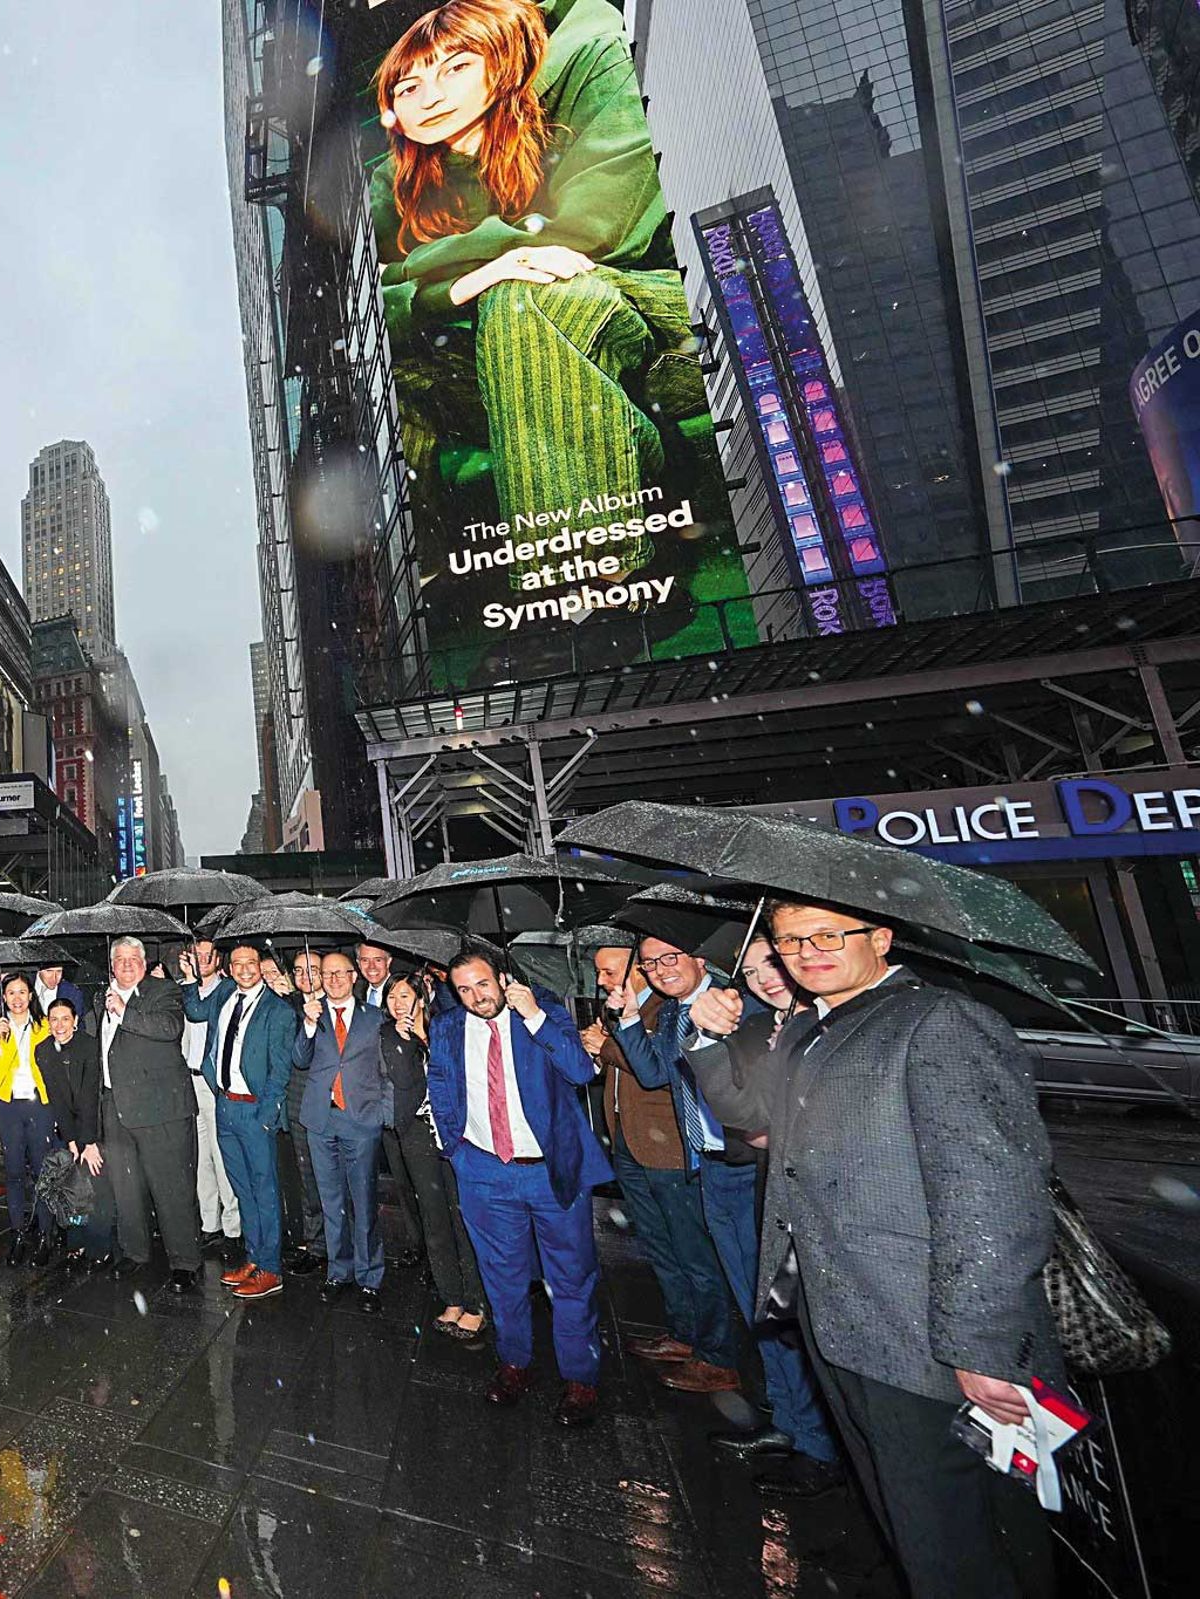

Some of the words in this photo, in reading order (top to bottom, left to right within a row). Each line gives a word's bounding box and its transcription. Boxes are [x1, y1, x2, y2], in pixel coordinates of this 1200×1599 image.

[1134, 345, 1182, 407] AGREE
[449, 500, 695, 575] Underdressed
[466, 521, 510, 542] The
[515, 507, 572, 532] New
[578, 486, 663, 518] Album
[521, 564, 557, 591] at
[560, 555, 619, 587] the
[483, 575, 675, 631] Symphony
[832, 798, 1040, 846] POLICE
